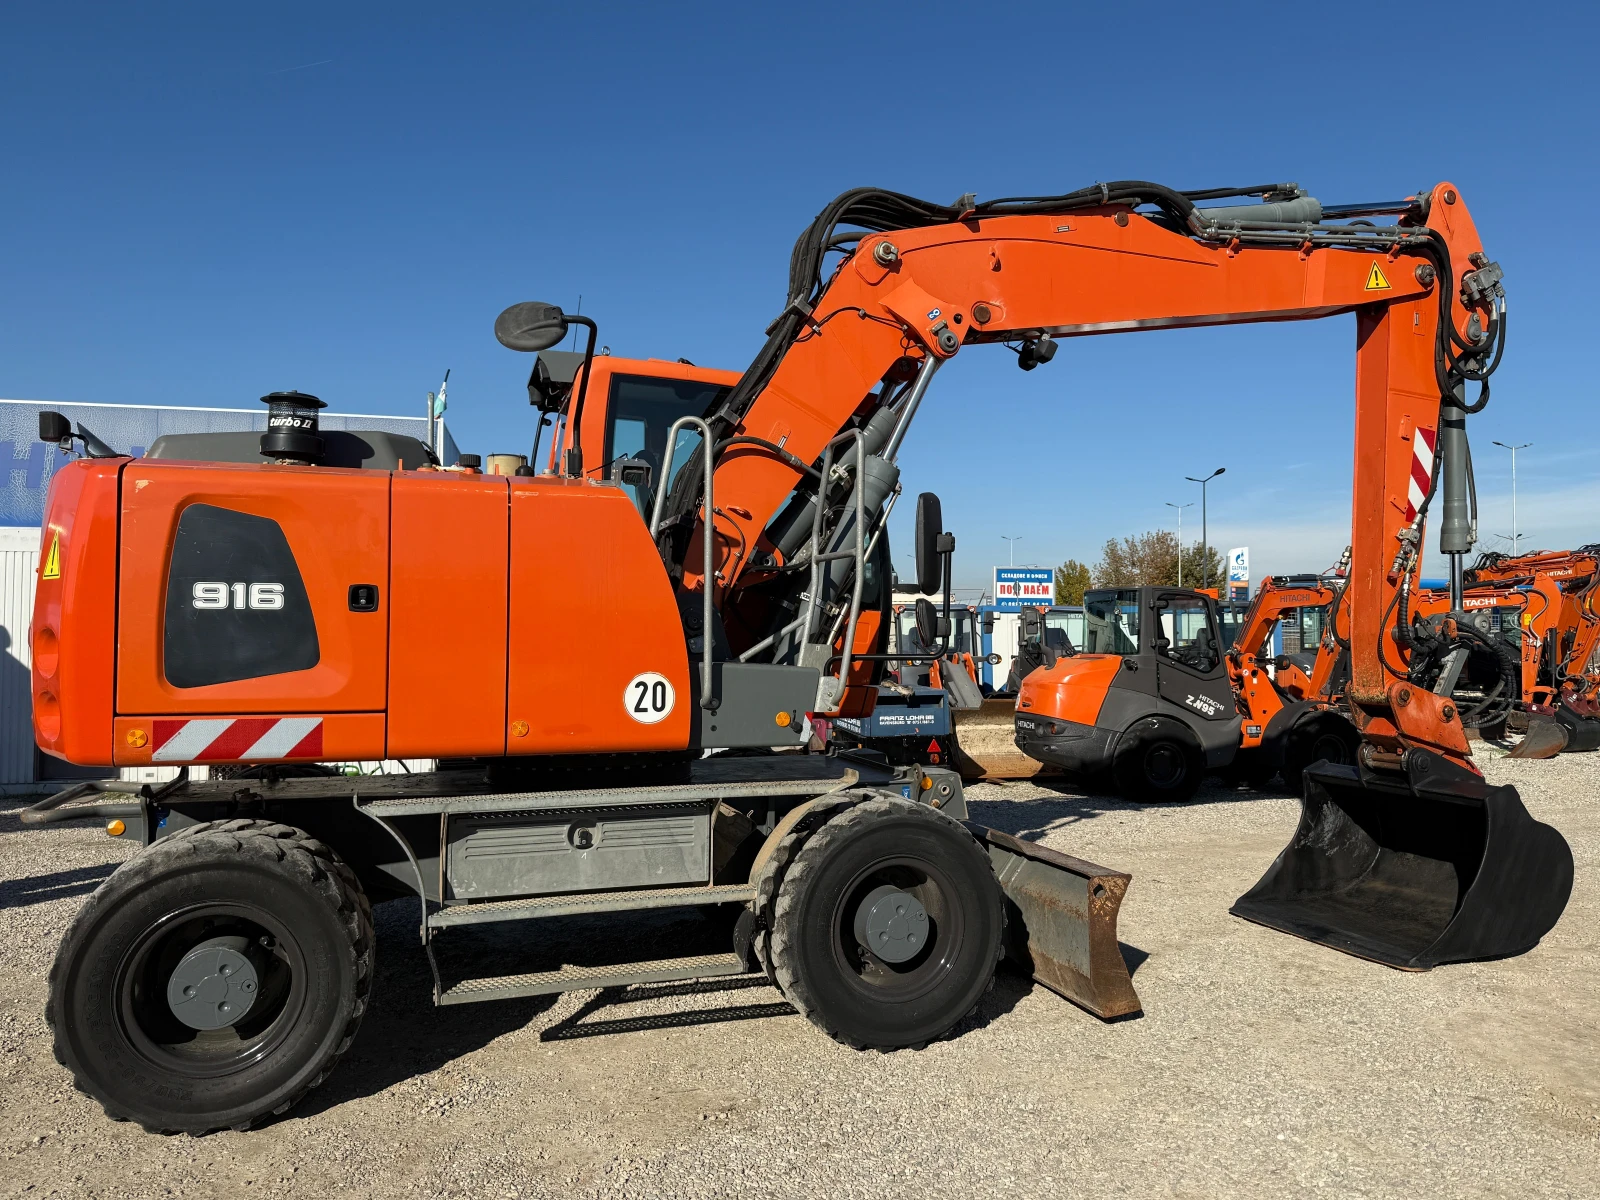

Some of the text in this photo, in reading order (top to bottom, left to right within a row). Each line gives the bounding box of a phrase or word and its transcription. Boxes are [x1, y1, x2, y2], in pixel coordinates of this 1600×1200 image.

[270, 416, 302, 427] turbo
[1546, 569, 1573, 577] HITACHI
[1000, 584, 1049, 596] ПО НАЕМ
[193, 582, 284, 610] 916
[1280, 593, 1311, 603] HITACHI
[634, 681, 666, 712] 20
[1199, 694, 1225, 711] HITACHI
[1017, 720, 1036, 730] HITACHI
